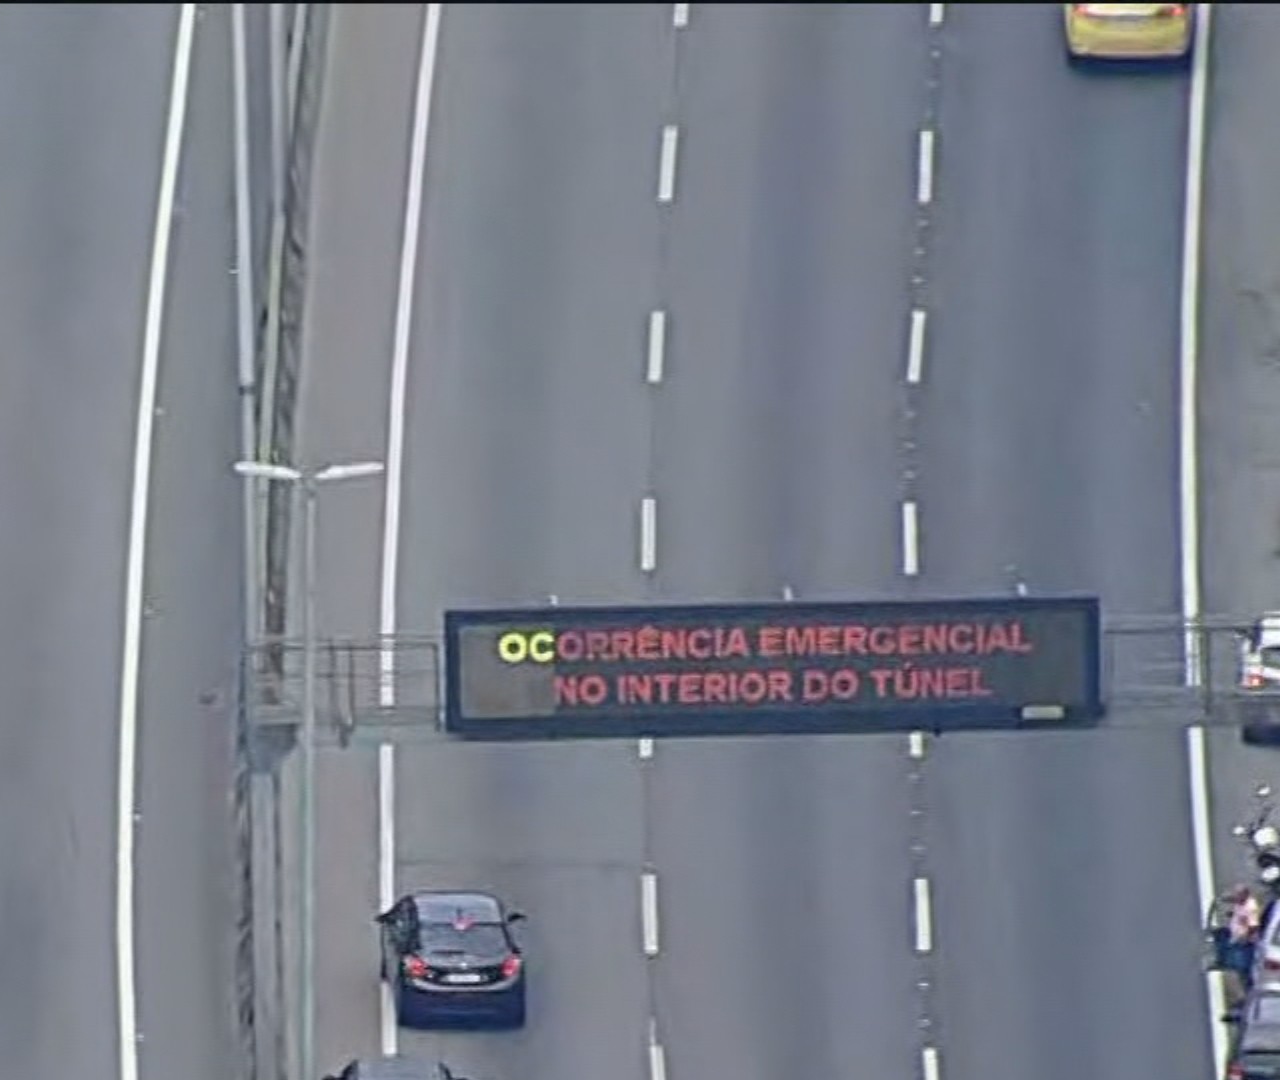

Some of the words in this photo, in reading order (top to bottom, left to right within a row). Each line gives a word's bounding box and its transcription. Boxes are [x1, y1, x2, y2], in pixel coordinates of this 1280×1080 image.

[497, 624, 747, 664] OCORRÊNCIA
[759, 622, 1031, 658] EMERGENCIAL
[553, 674, 607, 705] NO
[617, 671, 792, 704] INTERIOR
[802, 670, 859, 701] DO
[872, 664, 992, 698] TÚNEL
